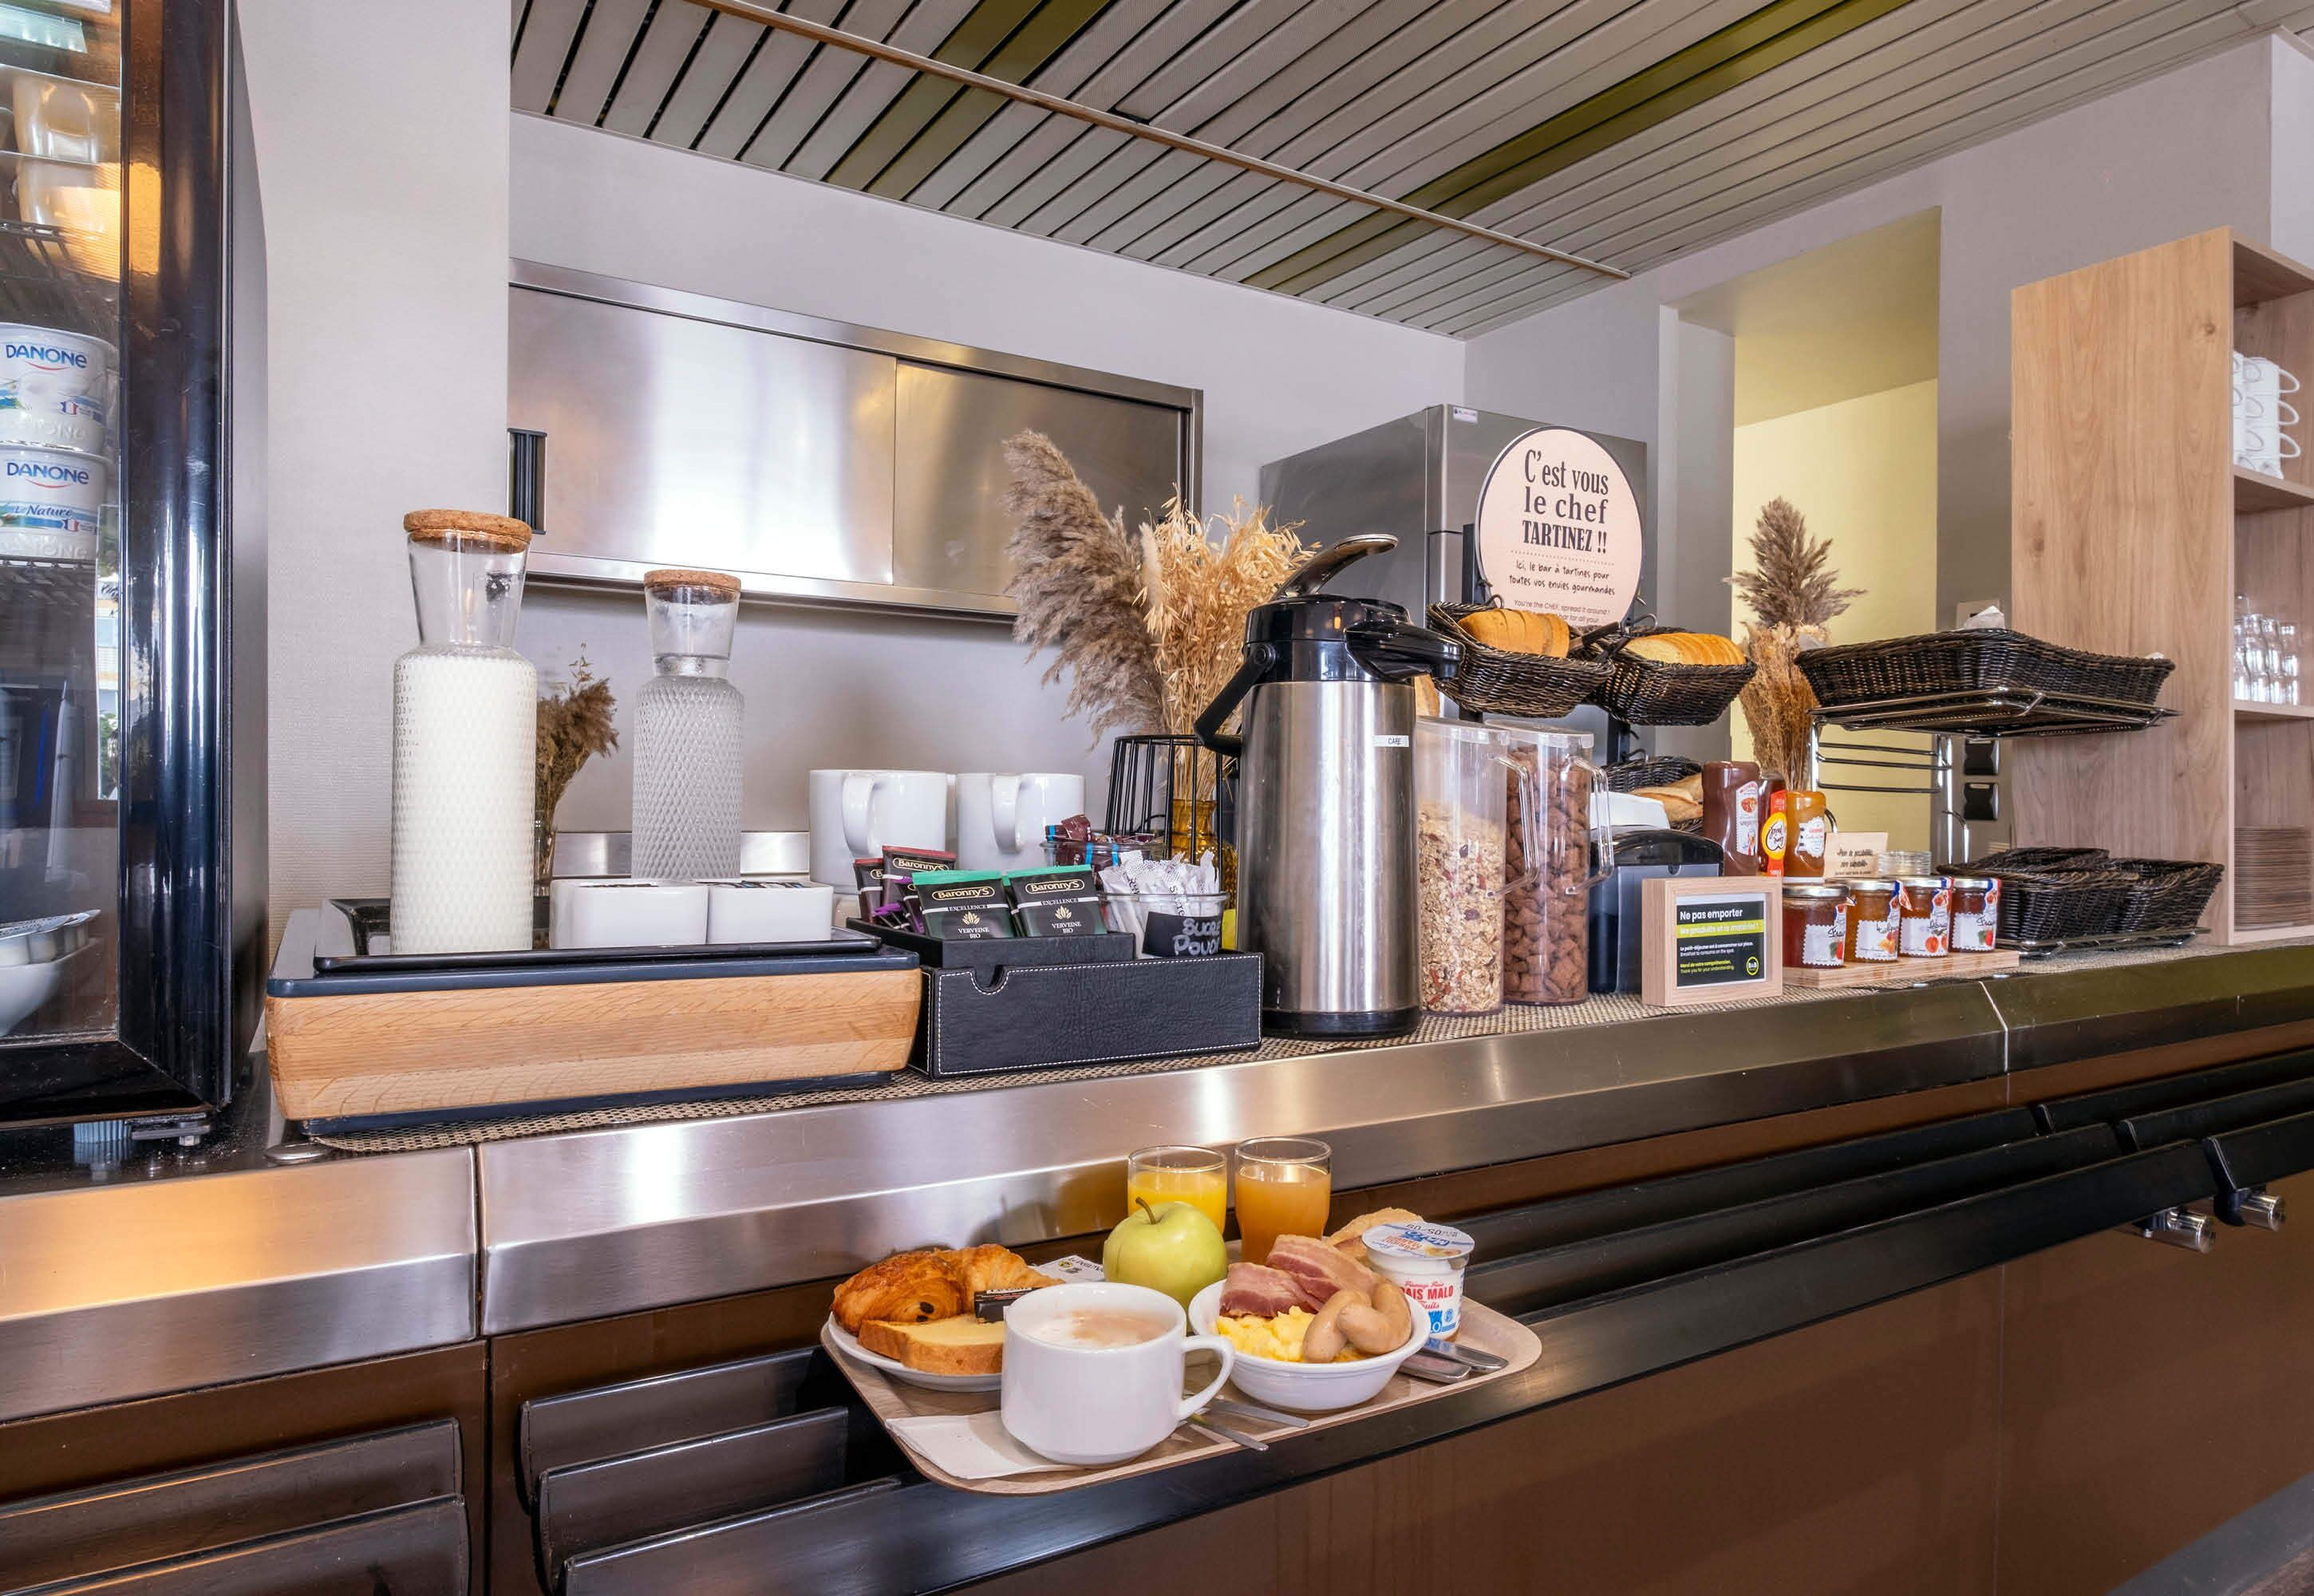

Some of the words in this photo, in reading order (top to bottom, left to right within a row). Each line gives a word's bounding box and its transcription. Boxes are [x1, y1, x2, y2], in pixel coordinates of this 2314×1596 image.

[1525, 449, 1566, 488] C'est
[1572, 469, 1609, 495] vous
[26, 504, 73, 518] Nature
[1524, 486, 1546, 515] le
[1555, 492, 1609, 523] chef
[1522, 519, 1593, 551] TARTINEZ
[1597, 531, 1607, 554] !!
[1516, 559, 1526, 571] Ici,
[1530, 562, 1535, 571] le
[1538, 563, 1552, 572] bar
[1554, 563, 1560, 574] à
[1563, 566, 1590, 578] tartines
[1593, 571, 1609, 581] pour
[1509, 575, 1530, 587] toutes
[1534, 579, 1545, 588] vos
[1548, 582, 1570, 591] envies
[1572, 583, 1615, 595] gourmandes
[1680, 911, 1691, 920] Ne
[1692, 911, 1706, 922] pas
[1708, 908, 1743, 921] emporter
[1427, 1286, 1454, 1300] MALO
